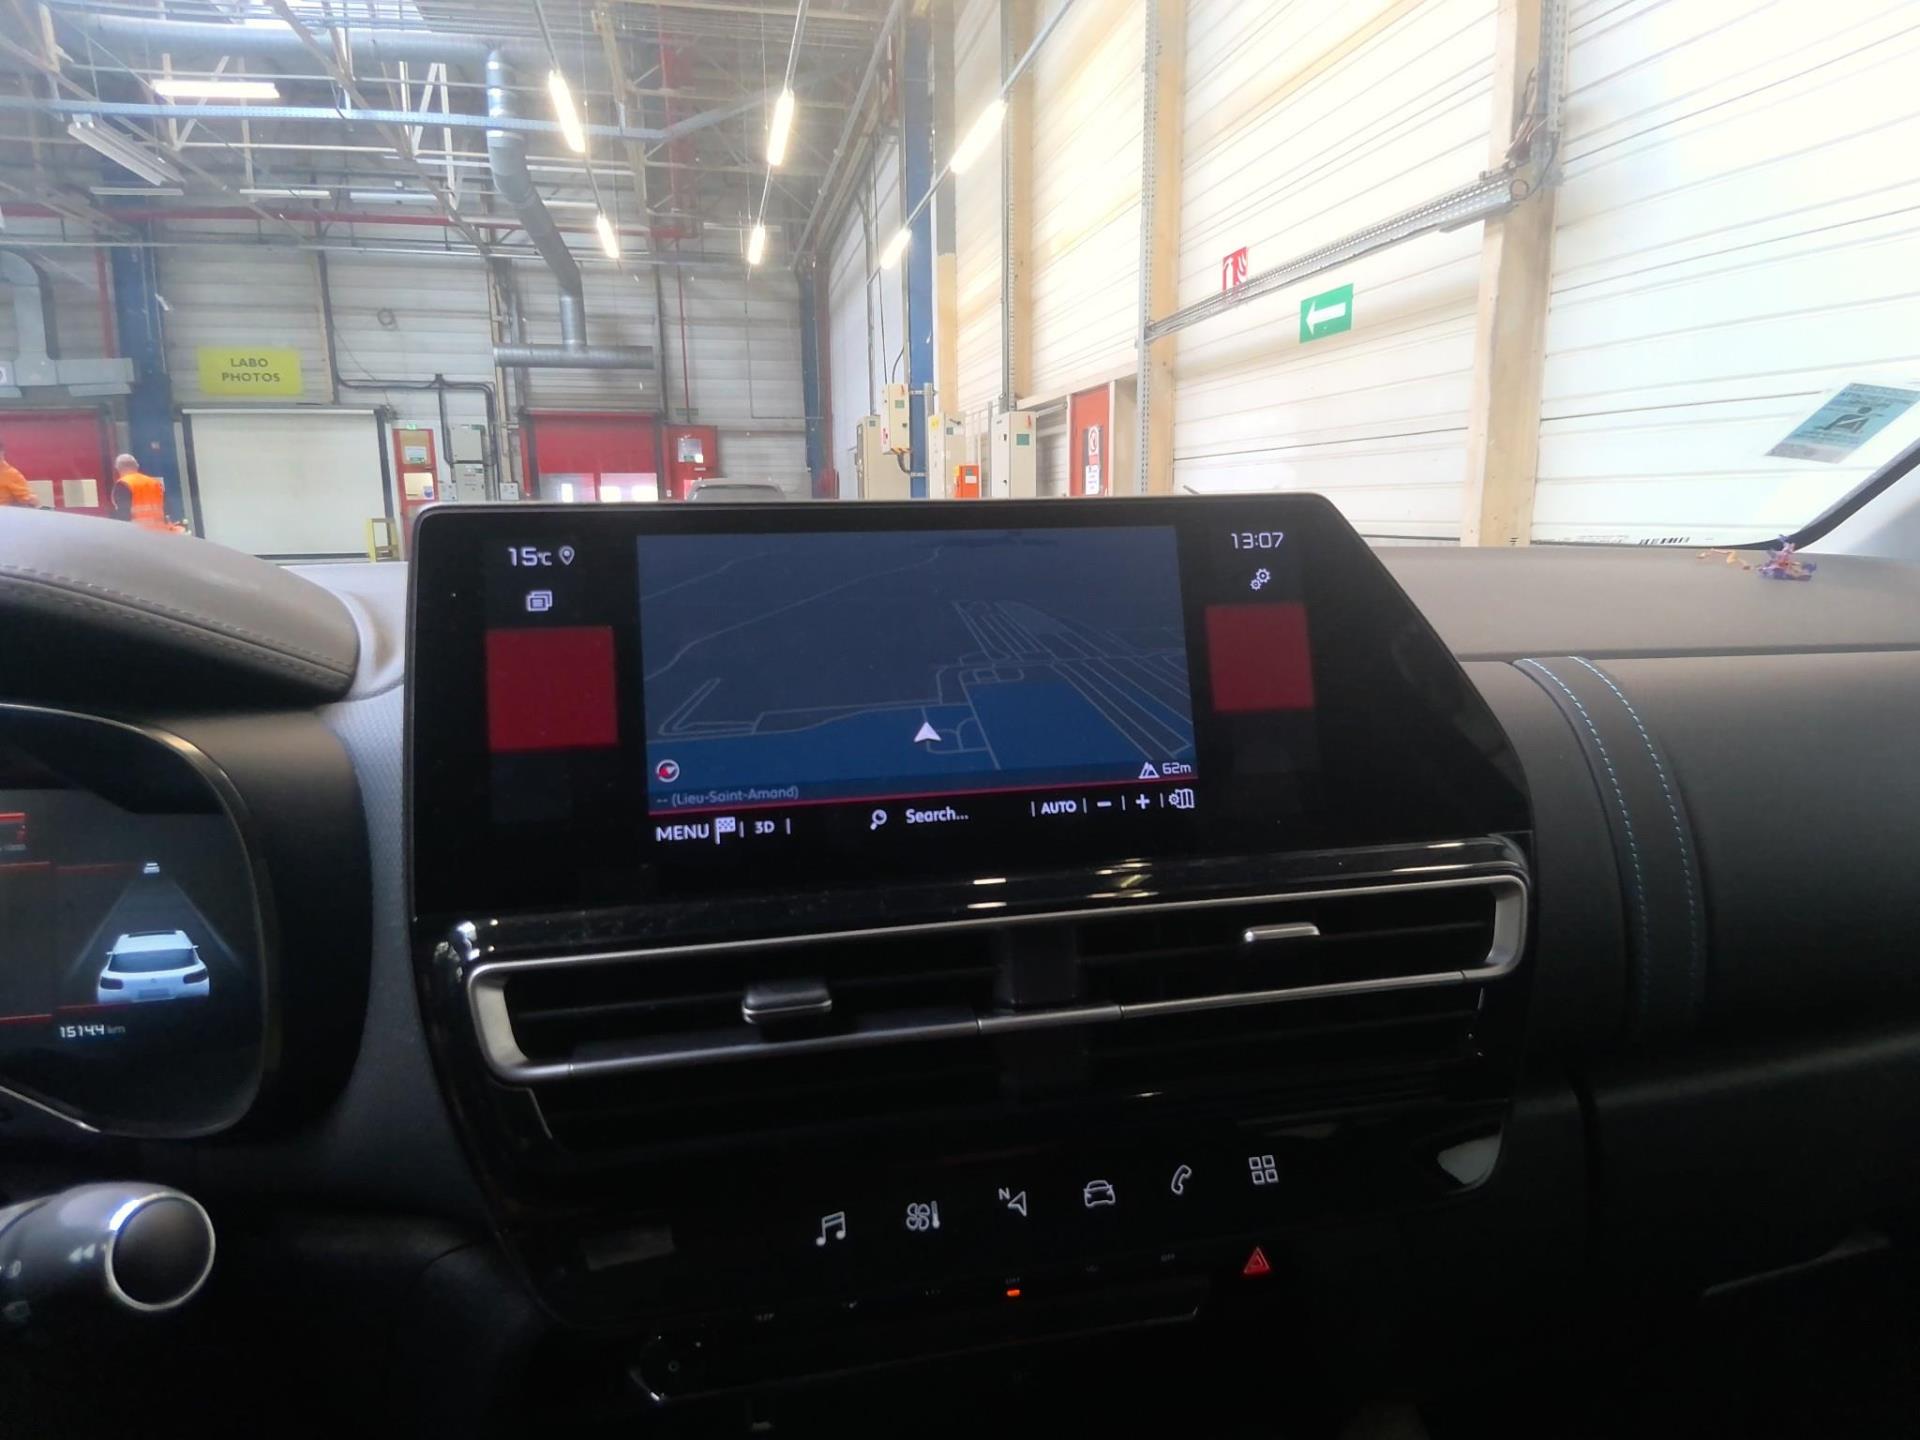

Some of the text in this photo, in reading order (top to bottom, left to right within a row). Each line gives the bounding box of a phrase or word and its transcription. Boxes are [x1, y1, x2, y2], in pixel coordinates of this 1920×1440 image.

[230, 358, 269, 368] LABO
[221, 372, 281, 382] PHOTOS
[1231, 532, 1284, 549] 13:07
[1161, 761, 1192, 776] 62m
[671, 785, 800, 807] (Lieu-Saint-Amand)
[905, 806, 969, 825] Search...
[1040, 799, 1078, 816] AUTO
[655, 822, 710, 842] MENU
[754, 820, 776, 835] 3D
[60, 1024, 105, 1038] 15144
